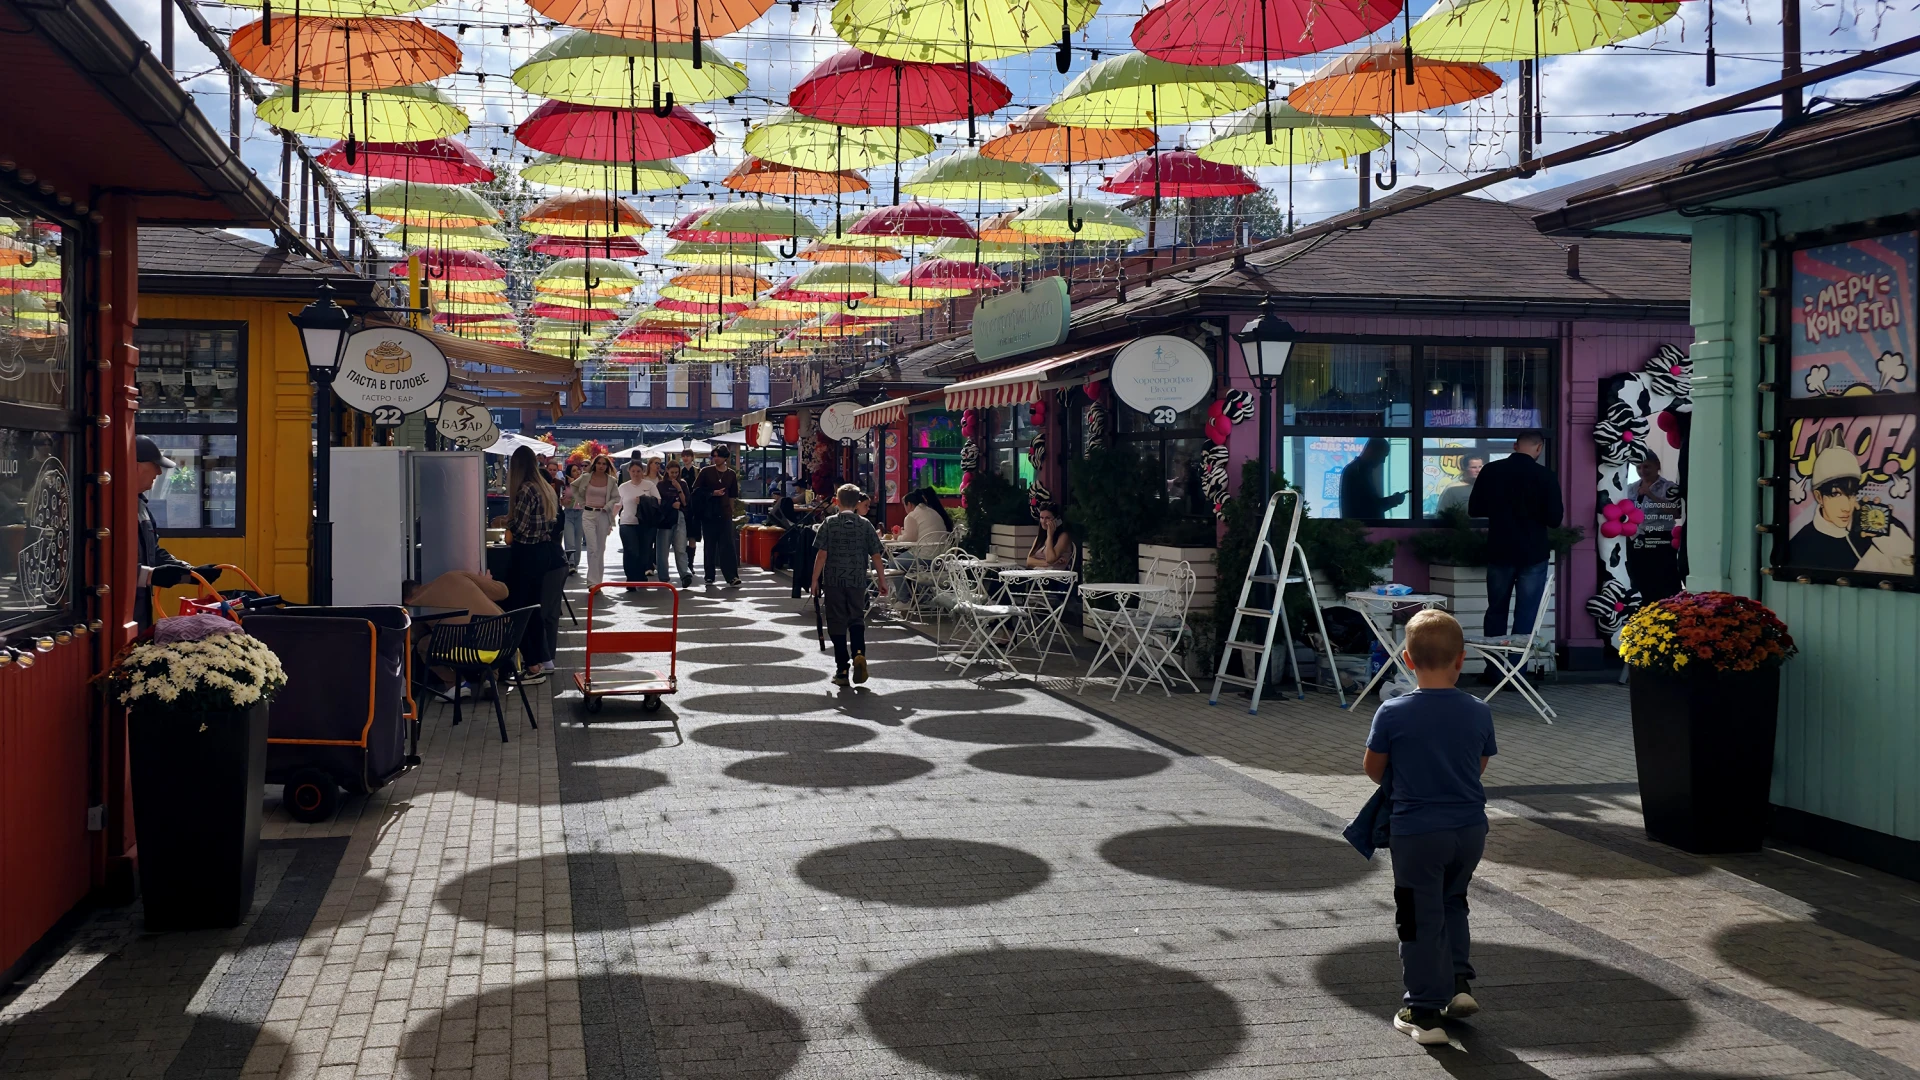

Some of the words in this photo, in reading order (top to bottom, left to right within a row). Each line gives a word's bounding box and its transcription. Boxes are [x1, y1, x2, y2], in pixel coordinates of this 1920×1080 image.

[1818, 274, 1875, 313] МЕРЧ
[1806, 298, 1900, 341] КОНФЕТЫ
[346, 369, 377, 390] ПАСТА
[380, 380, 387, 390] В
[390, 372, 430, 391] ГОЛОВЕ
[361, 394, 392, 402] ГАСТРО
[375, 408, 402, 425] 22
[441, 411, 483, 432] БАЗАР
[1153, 408, 1177, 424] 29
[455, 438, 469, 446] 23
[841, 438, 851, 447] 31
